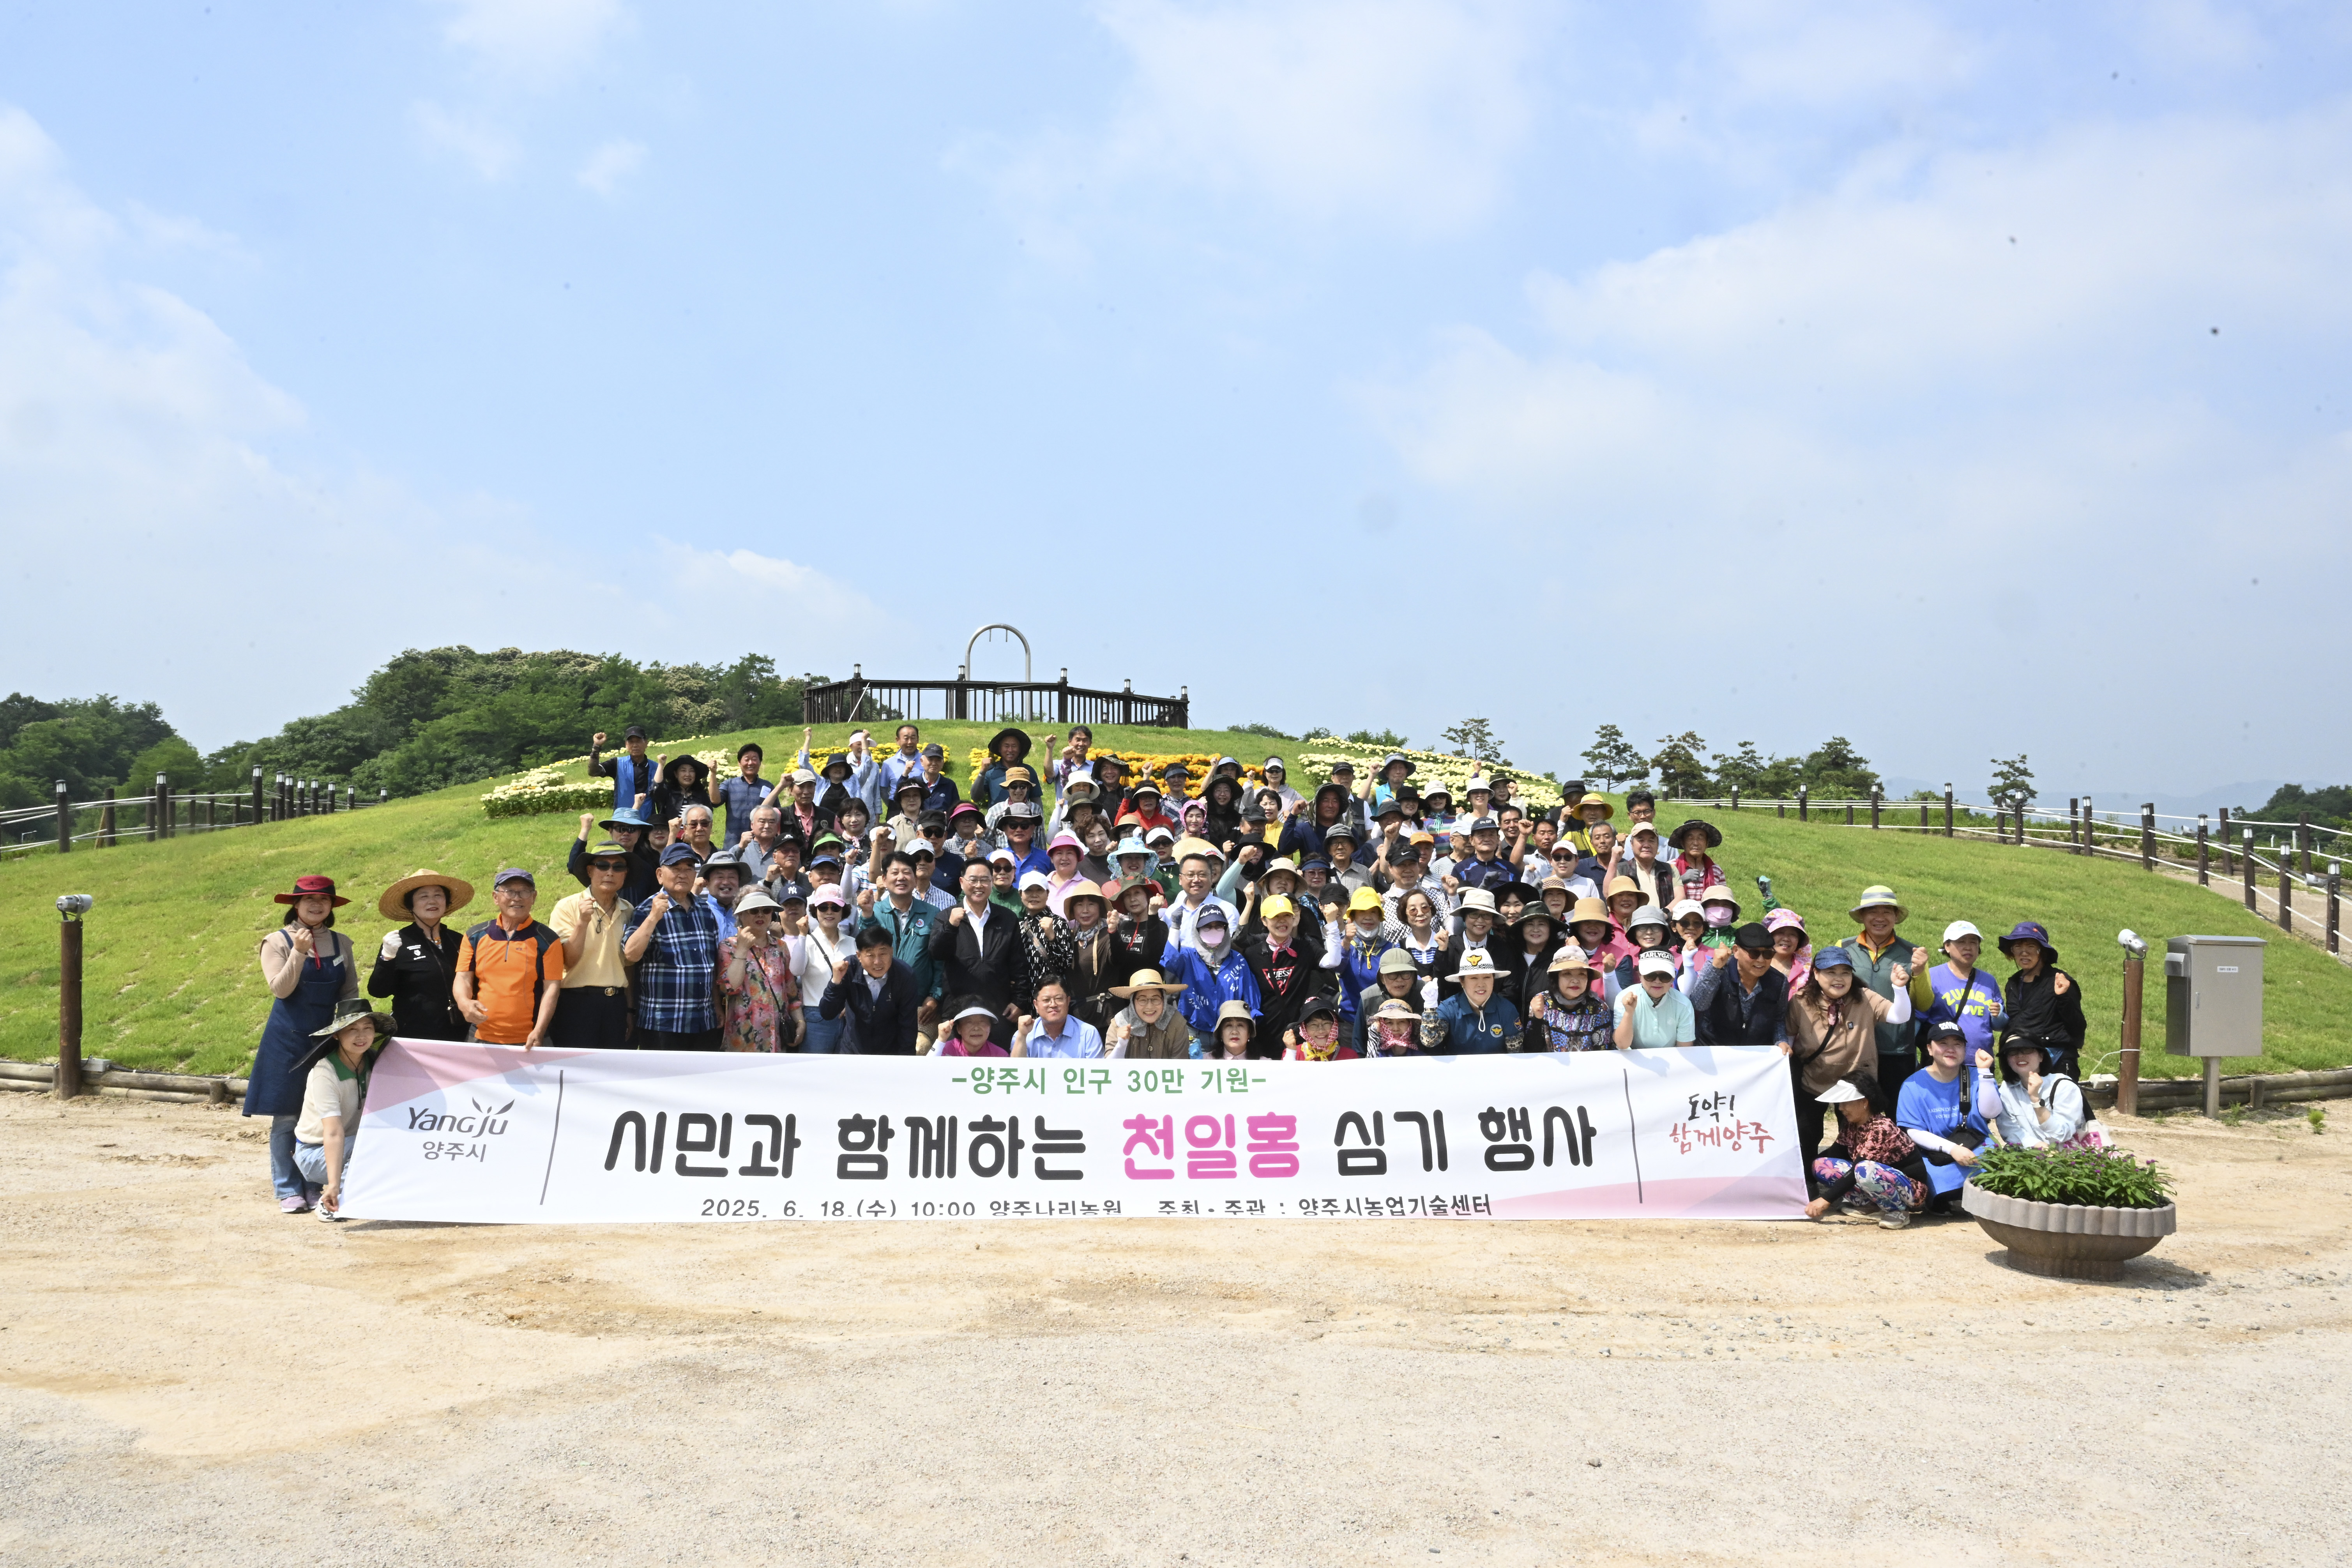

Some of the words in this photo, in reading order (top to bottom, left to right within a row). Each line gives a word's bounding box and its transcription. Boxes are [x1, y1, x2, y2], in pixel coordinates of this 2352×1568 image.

[1064, 1068, 1112, 1094] 인구
[1128, 1069, 1184, 1093] 30만
[1688, 1091, 1735, 1123] 도약!
[423, 1141, 486, 1162] 양주시
[604, 1110, 801, 1179] 시민과
[837, 1113, 1086, 1180] 함께하는
[1123, 1111, 1300, 1179] 천일홍
[1334, 1109, 1448, 1176] 심기
[1478, 1105, 1597, 1172] 행사
[701, 1199, 767, 1218] 2025.
[783, 1200, 804, 1217] 6.
[911, 1202, 975, 1216] 10:00
[990, 1200, 1122, 1216] 양주나리농원
[1225, 1199, 1266, 1215] 주관
[1299, 1194, 1492, 1216] 양주시농업기술센터
